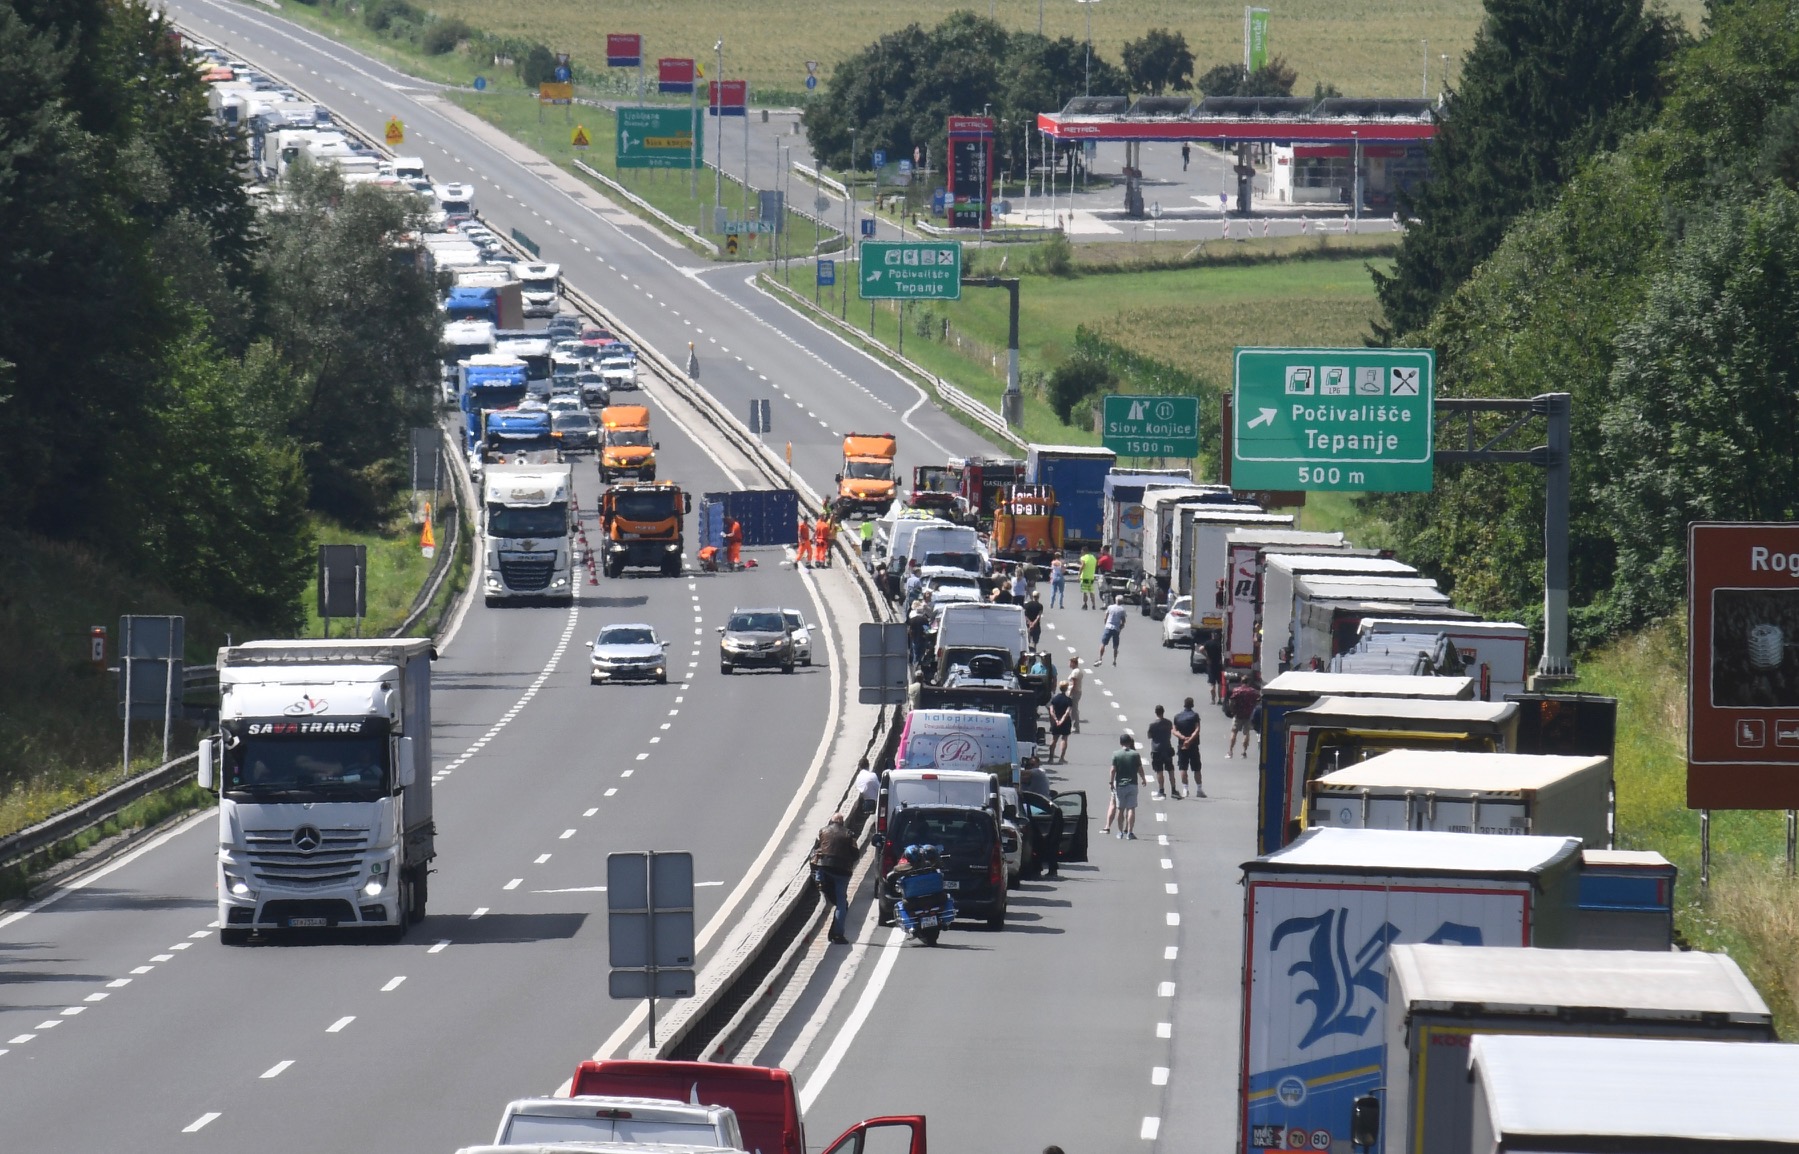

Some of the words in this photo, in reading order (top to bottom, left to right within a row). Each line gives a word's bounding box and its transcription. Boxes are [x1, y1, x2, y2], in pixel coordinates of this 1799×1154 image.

[895, 281, 944, 295] Tepanje
[1160, 405, 1170, 416] 11
[1292, 404, 1412, 422] Počivališče
[1110, 421, 1141, 433] Slov.
[1145, 422, 1191, 436] Konjice
[1127, 441, 1158, 453] 1500
[1163, 444, 1174, 453] m
[1304, 429, 1399, 455] Tepanje
[1298, 466, 1341, 484] 500
[1348, 471, 1365, 484] m
[924, 713, 995, 724] halopixi.si
[940, 738, 977, 762] Pixi
[1292, 1134, 1304, 1145] 70
[1313, 1134, 1328, 1145] 80
